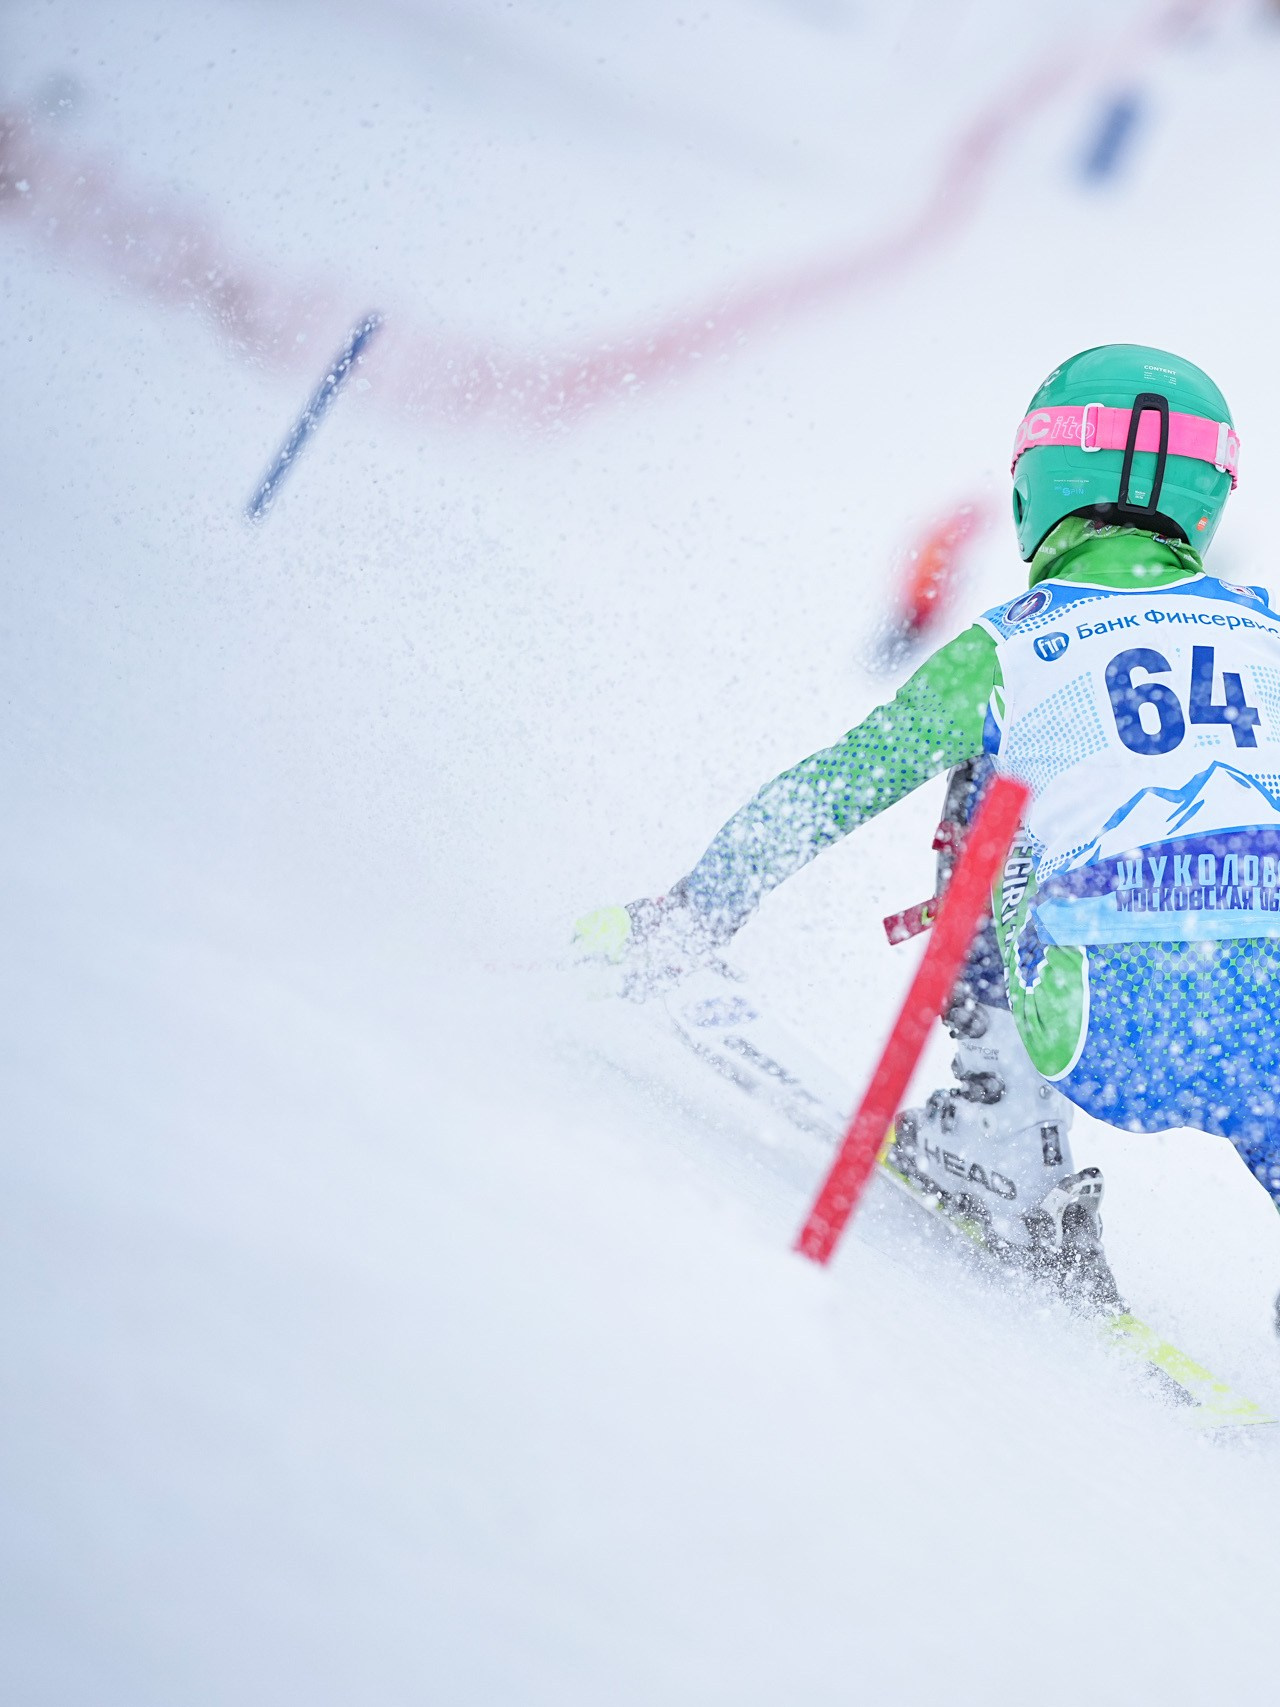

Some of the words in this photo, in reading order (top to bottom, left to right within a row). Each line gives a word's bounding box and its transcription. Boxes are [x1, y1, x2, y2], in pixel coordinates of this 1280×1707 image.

[1143, 364, 1177, 376] CONTENT
[1076, 612, 1141, 640] Банк
[1104, 645, 1262, 755] 64
[1116, 886, 1254, 912] МОСКОВСКАЯ
[923, 1138, 1017, 1200] HEAD
